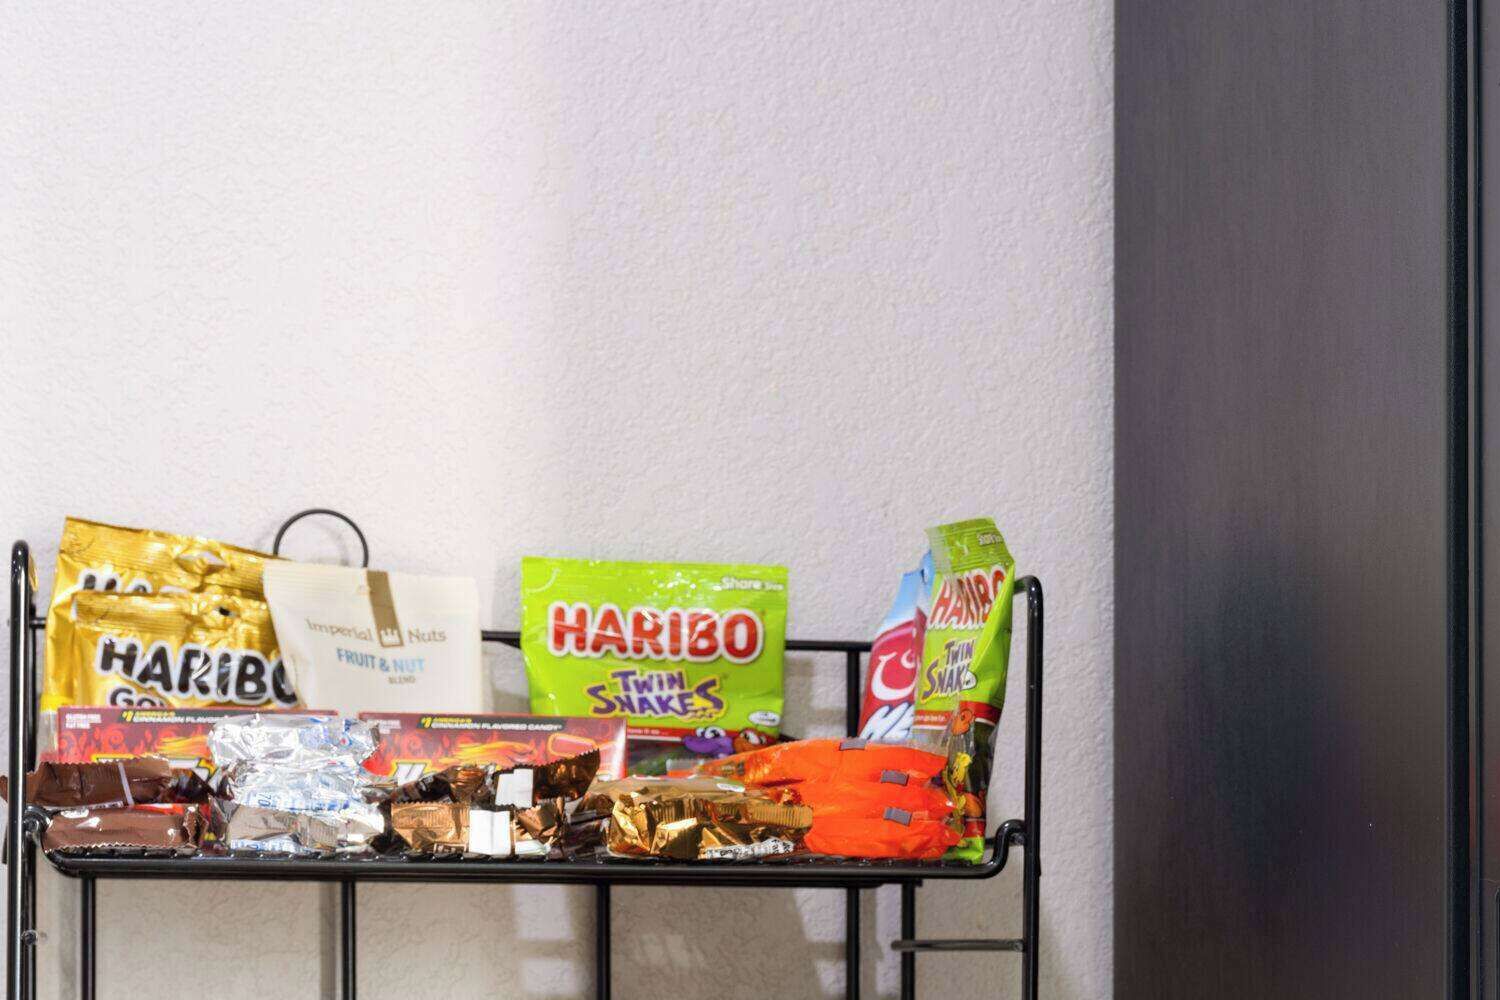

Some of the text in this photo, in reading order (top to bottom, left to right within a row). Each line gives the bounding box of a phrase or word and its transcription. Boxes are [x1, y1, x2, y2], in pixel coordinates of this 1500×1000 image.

[720, 577, 762, 591] Share
[304, 617, 447, 643] Imperial Nuts
[551, 604, 761, 662] HARIBO
[336, 648, 425, 673] FRUIT & NUT
[611, 670, 686, 694] TWIN
[585, 678, 725, 716] SNAKES
